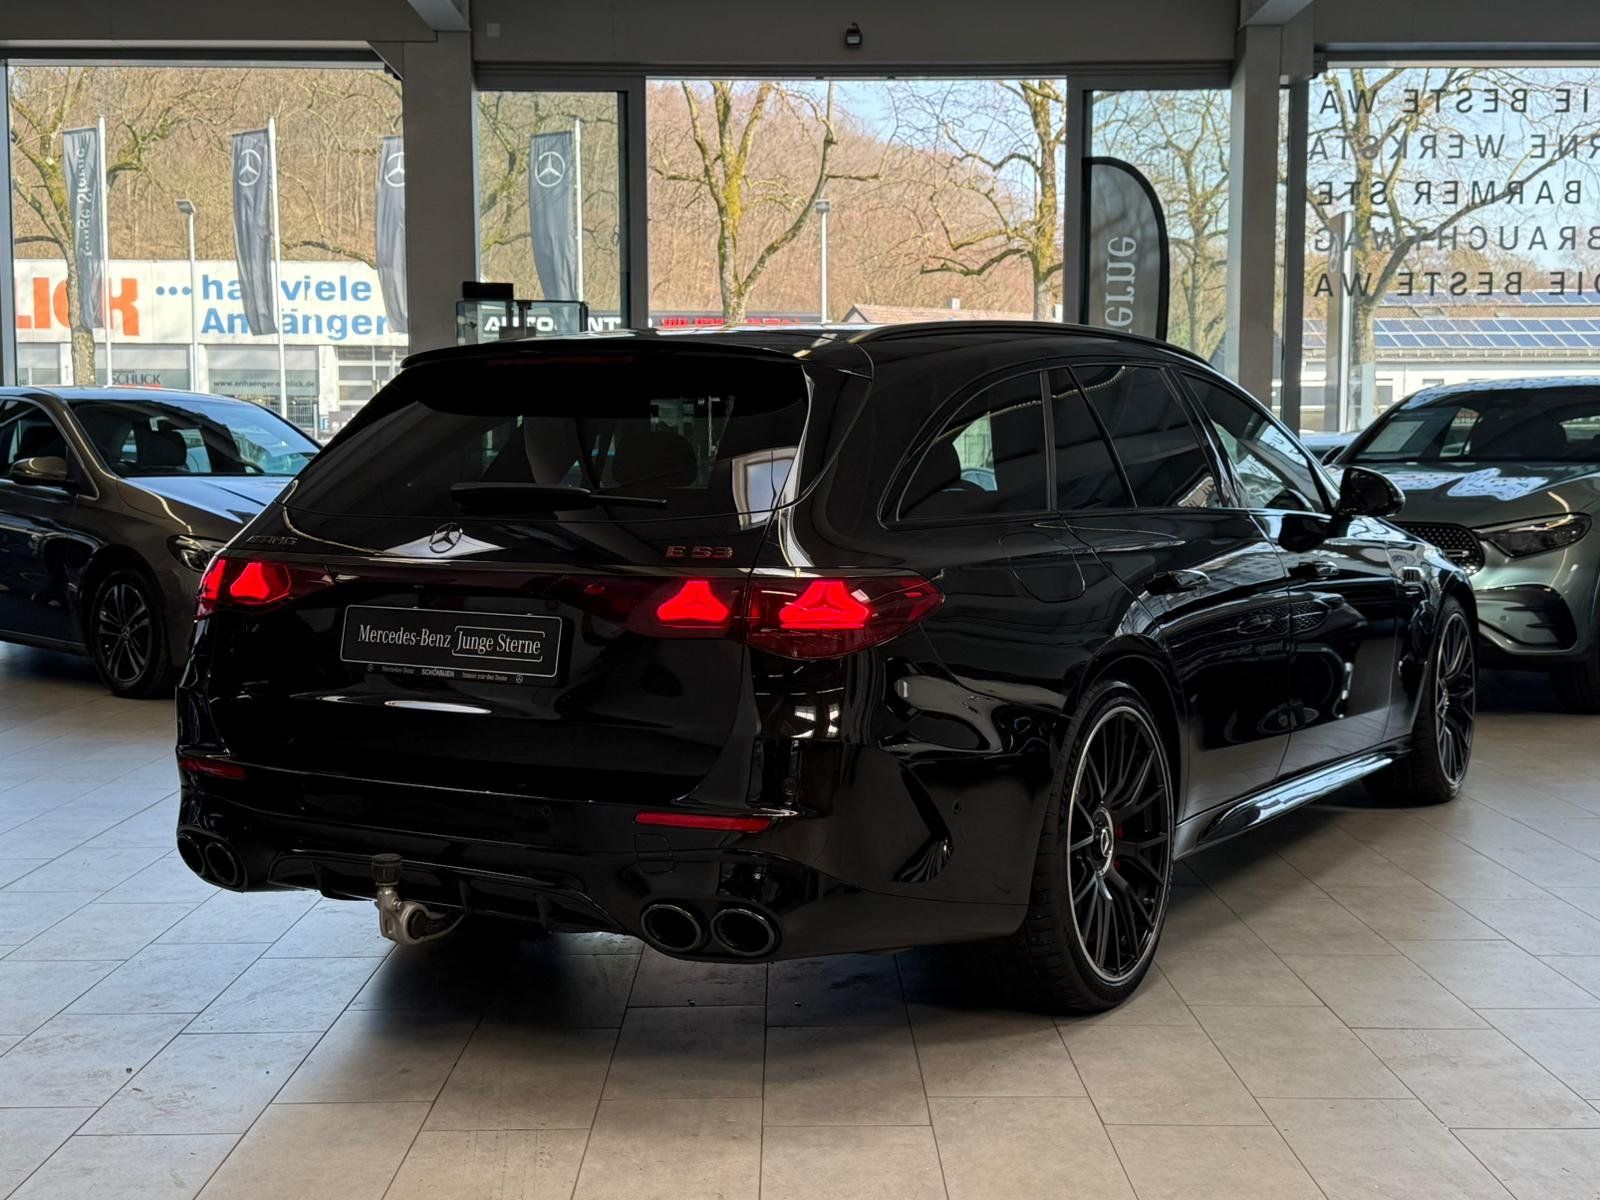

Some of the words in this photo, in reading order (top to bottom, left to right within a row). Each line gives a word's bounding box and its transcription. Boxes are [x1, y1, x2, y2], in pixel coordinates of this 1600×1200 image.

[280, 275, 372, 302] viele
[201, 307, 389, 341] Anänger
[665, 545, 687, 559] E
[692, 545, 734, 560] 53
[357, 624, 452, 648] Mercedes-Benz
[456, 630, 494, 655] Junge
[496, 633, 541, 655] Sterne
